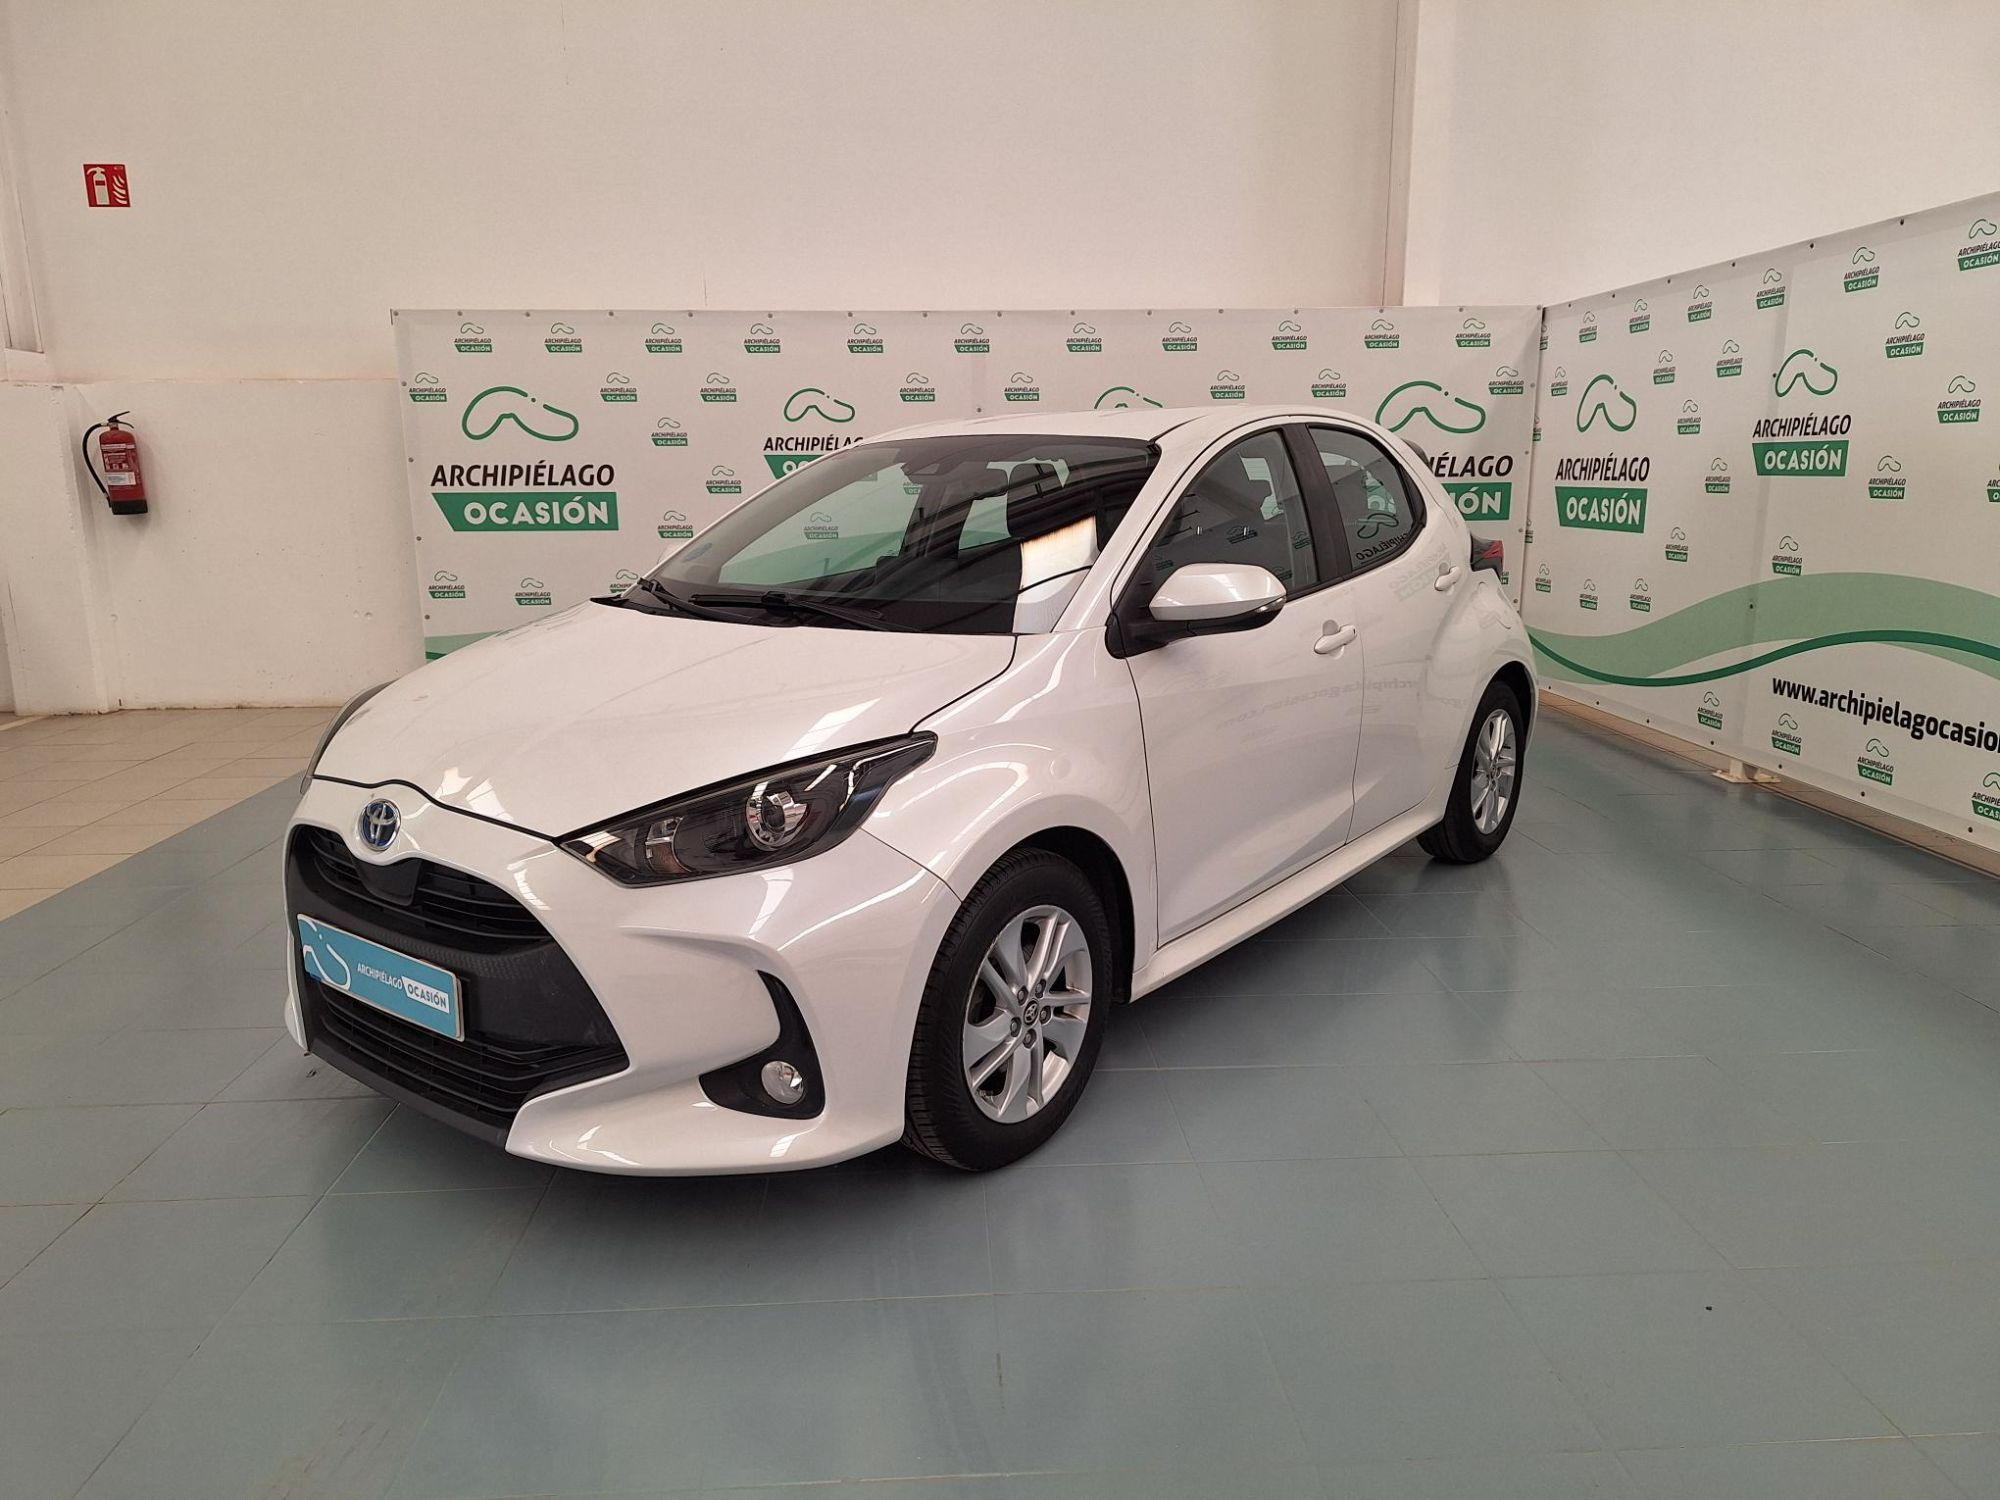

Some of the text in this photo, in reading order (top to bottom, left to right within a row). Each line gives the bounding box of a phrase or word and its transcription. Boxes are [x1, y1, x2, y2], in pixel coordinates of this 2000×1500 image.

[1963, 253, 1999, 268] OCASIÓN
[1848, 278, 1876, 290] OCASIÓN
[1885, 333, 1925, 345] ARCHIPIÉLAGO
[1890, 344, 1922, 356] OCASIÓN
[1937, 400, 1981, 410] ARCHIPIÉLAGO
[1942, 411, 1977, 421] OCASIÓN
[1752, 412, 1851, 438] ARCHIPIÉLAGO
[1430, 452, 1513, 477] IÉLAGO
[1764, 444, 1842, 471] OCASIÓN
[431, 460, 615, 487] ARCHIPIÉLAGO
[1555, 452, 1650, 482] ARCHIPIÉLAGO
[1868, 477, 1906, 486] ARCHIPIÉLAGO
[1872, 488, 1903, 498] OCASIÓN
[463, 496, 609, 525] OCASIÓN
[1566, 493, 1641, 525] OCASIÓN
[1772, 678, 2000, 753] www.archipielagocasio
[1862, 768, 1891, 784] OCASIÓN
[1978, 806, 2000, 819] OCAS
[357, 963, 447, 1008] ARCHIPIÉLAGO OCASIÓN
